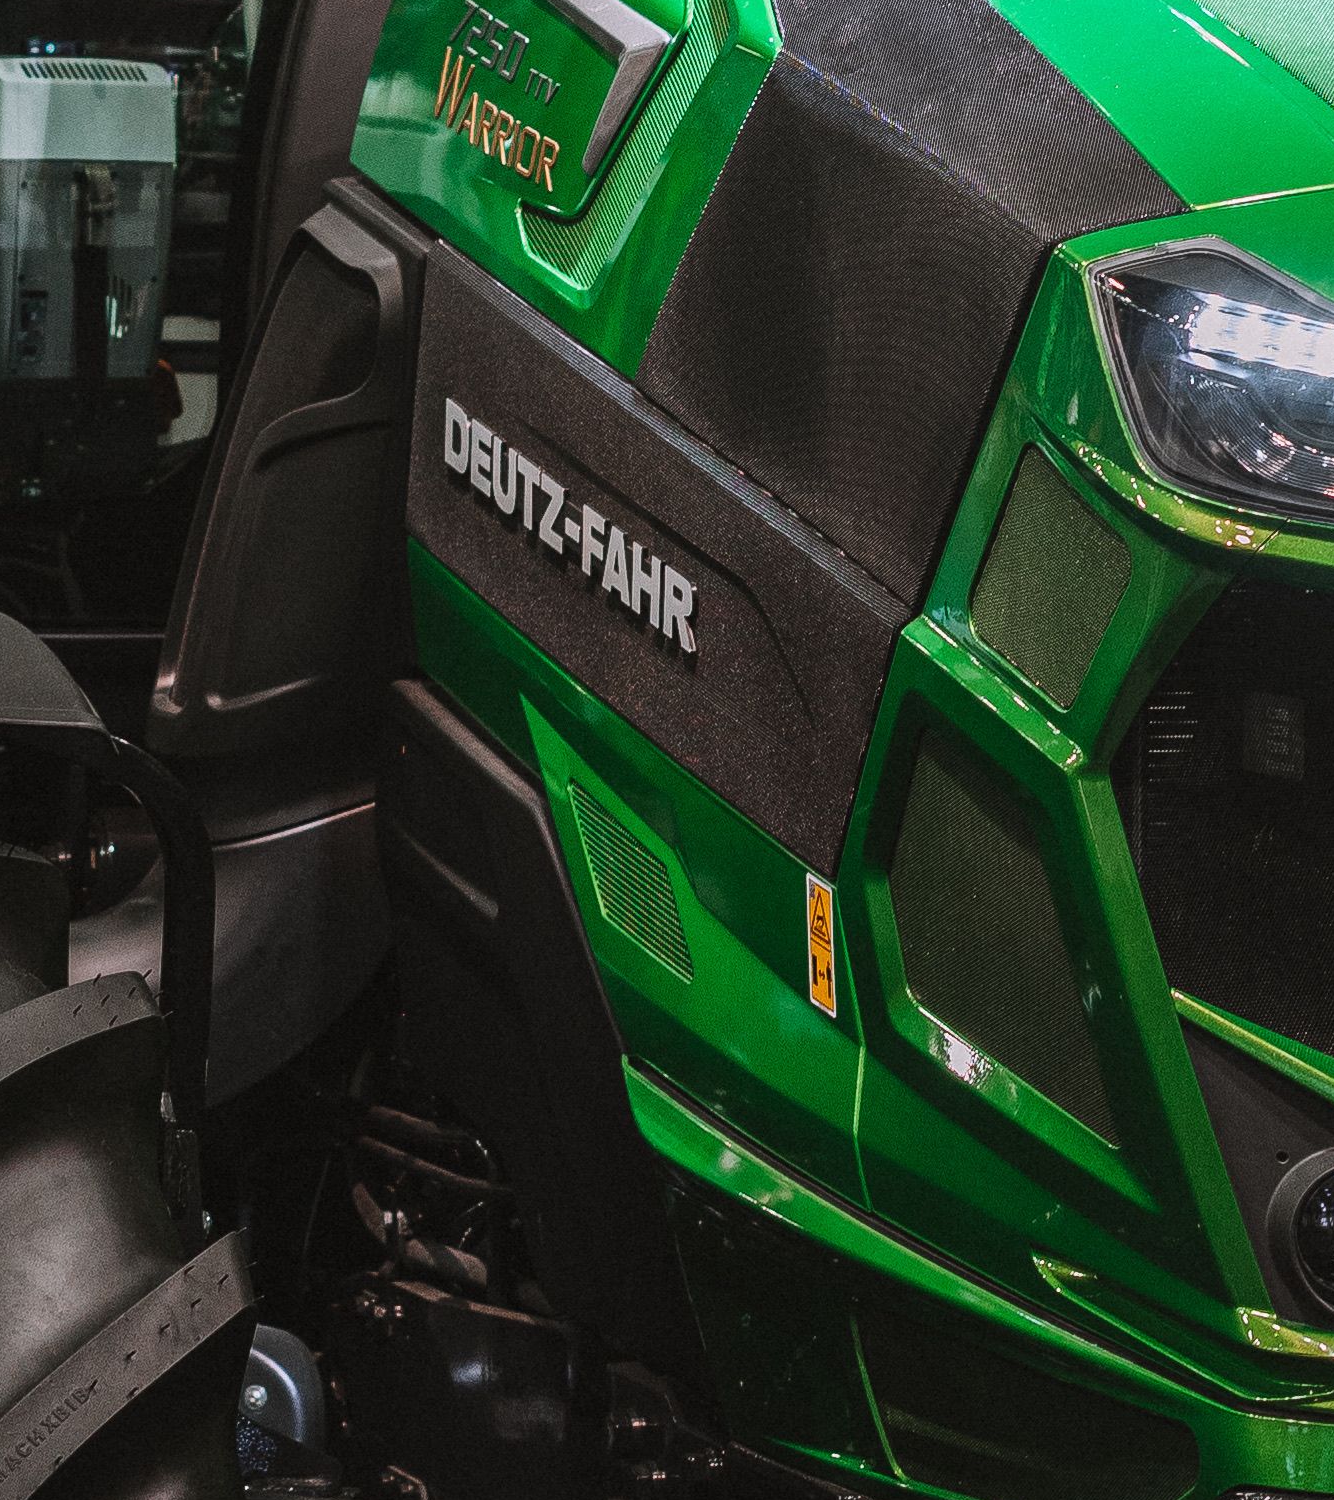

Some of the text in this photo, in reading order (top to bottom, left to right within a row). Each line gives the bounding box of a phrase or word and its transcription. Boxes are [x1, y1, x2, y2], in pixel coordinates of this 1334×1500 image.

[433, 45, 561, 192] WARRIOR
[524, 67, 561, 105] TTV
[444, 397, 698, 653] DEUTZ-FAHR
